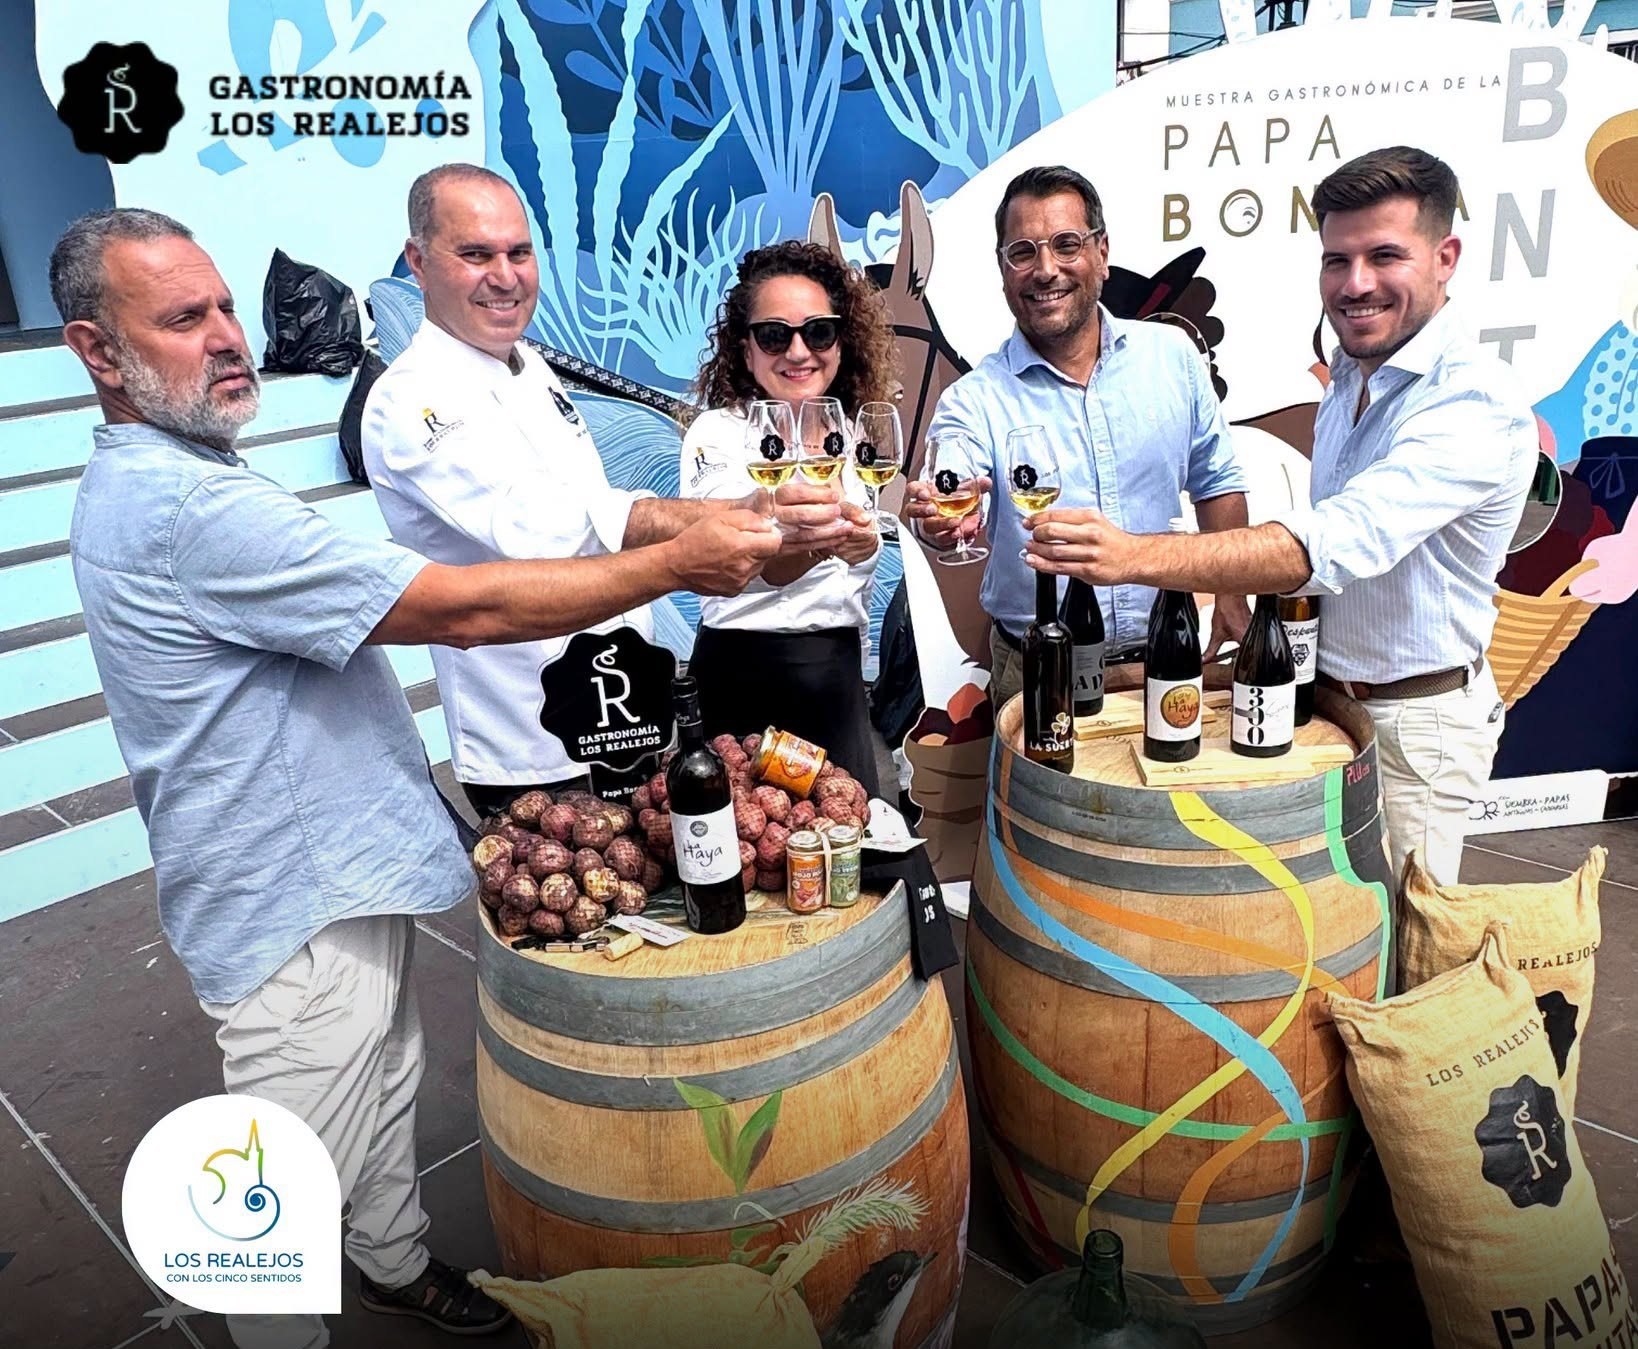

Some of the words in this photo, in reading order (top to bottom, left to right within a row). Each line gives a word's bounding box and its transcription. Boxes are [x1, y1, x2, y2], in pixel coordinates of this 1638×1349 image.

[1166, 91, 1254, 108] MUESTRA
[1268, 79, 1430, 102] GASTRONÓMICA
[1443, 76, 1466, 90] DE
[1480, 75, 1502, 88] LA
[1164, 114, 1341, 170] PAPA
[578, 724, 661, 745] GASTRONOMÍA
[580, 743, 602, 756] LOS
[606, 736, 661, 752] REALEJOS
[683, 842, 723, 867] Haya
[1517, 941, 1599, 971] REALEJOS
[1426, 1064, 1464, 1087] LOS
[1490, 1243, 1622, 1349] PAPA
